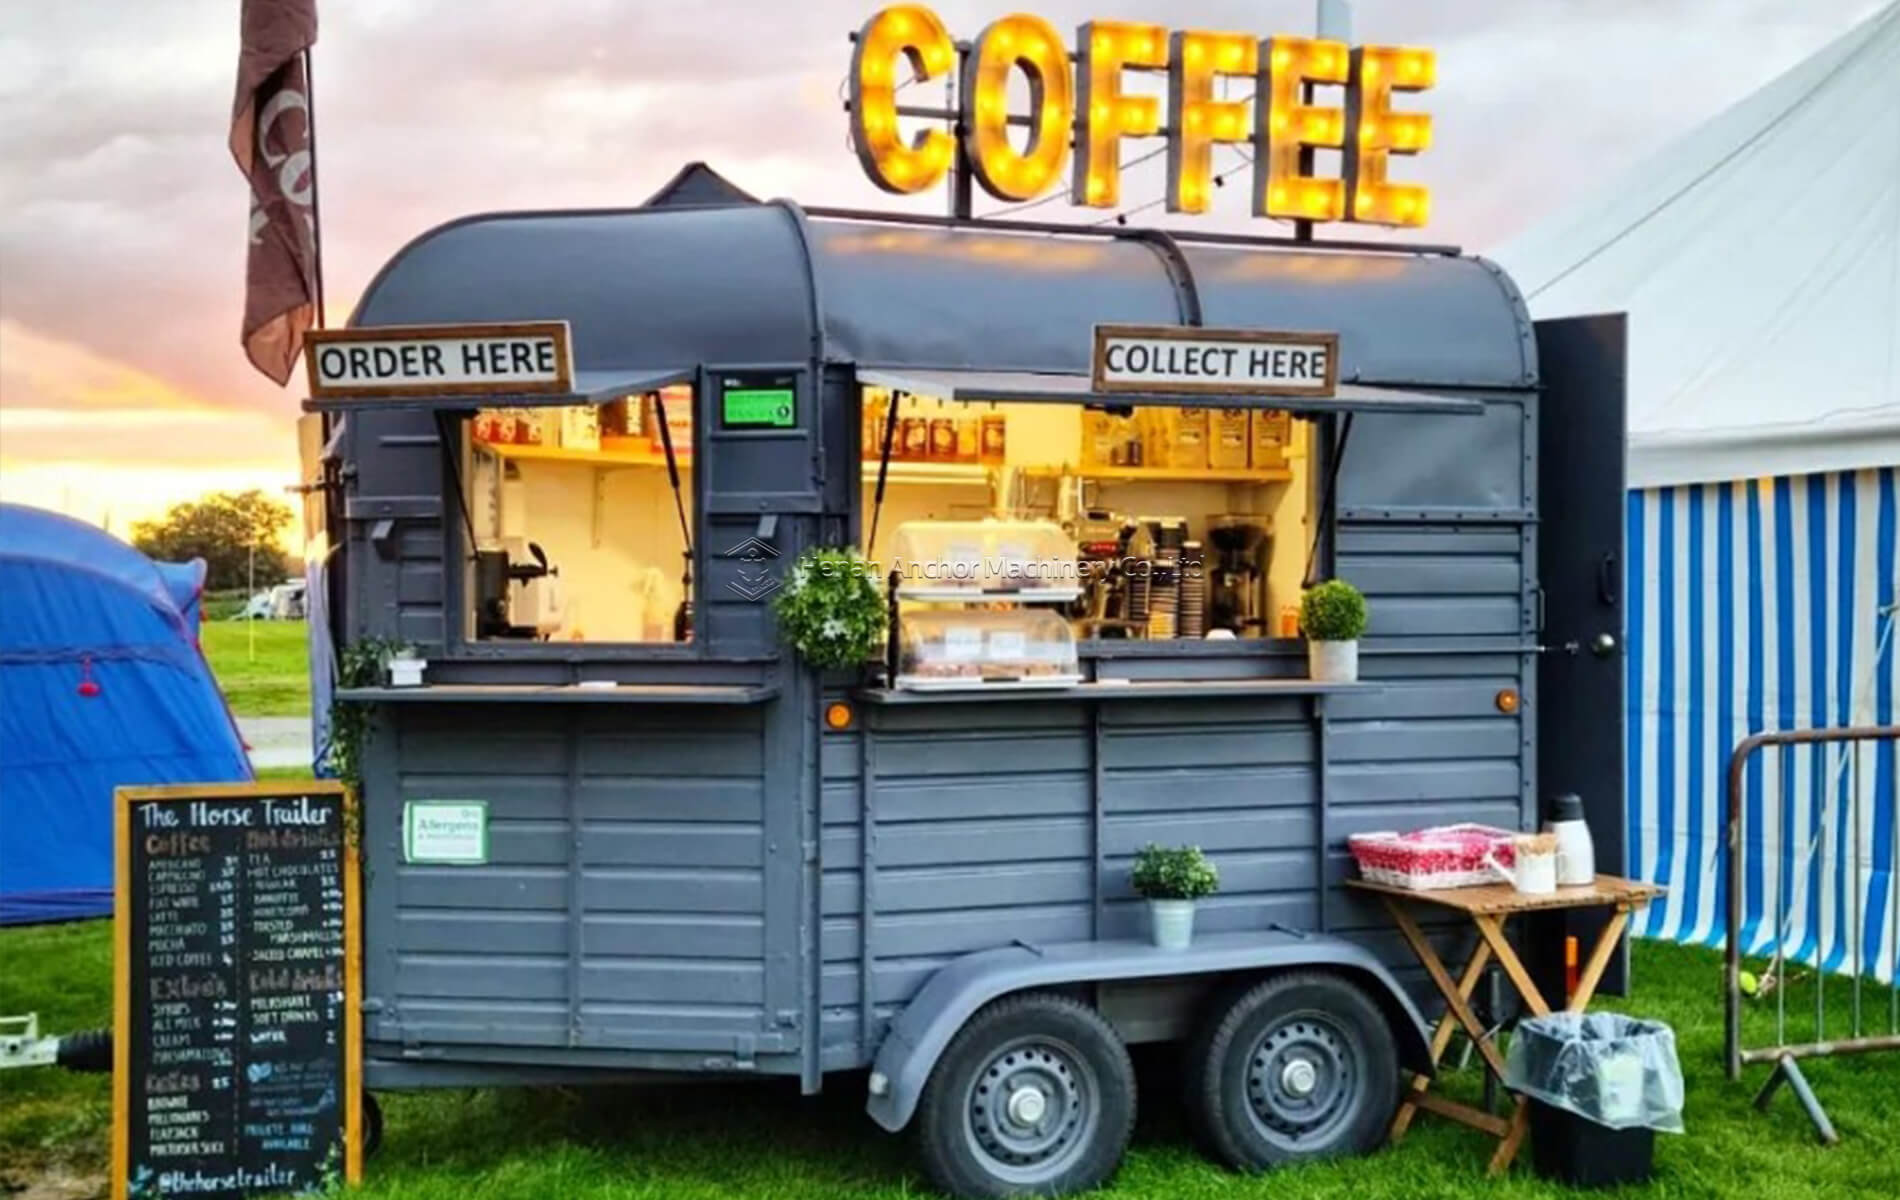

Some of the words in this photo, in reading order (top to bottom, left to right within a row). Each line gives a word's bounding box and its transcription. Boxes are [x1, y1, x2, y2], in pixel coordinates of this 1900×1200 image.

[851, 2, 1437, 228] COFFEE
[320, 345, 446, 379] ORDER
[461, 342, 555, 375] HERE
[1105, 344, 1239, 376] COLLECT
[1249, 350, 1325, 379] HERE
[138, 802, 180, 828] The
[190, 802, 254, 827] Horse
[260, 796, 332, 825] Trailer
[419, 818, 480, 834] Allergens
[146, 832, 210, 856] Coffee
